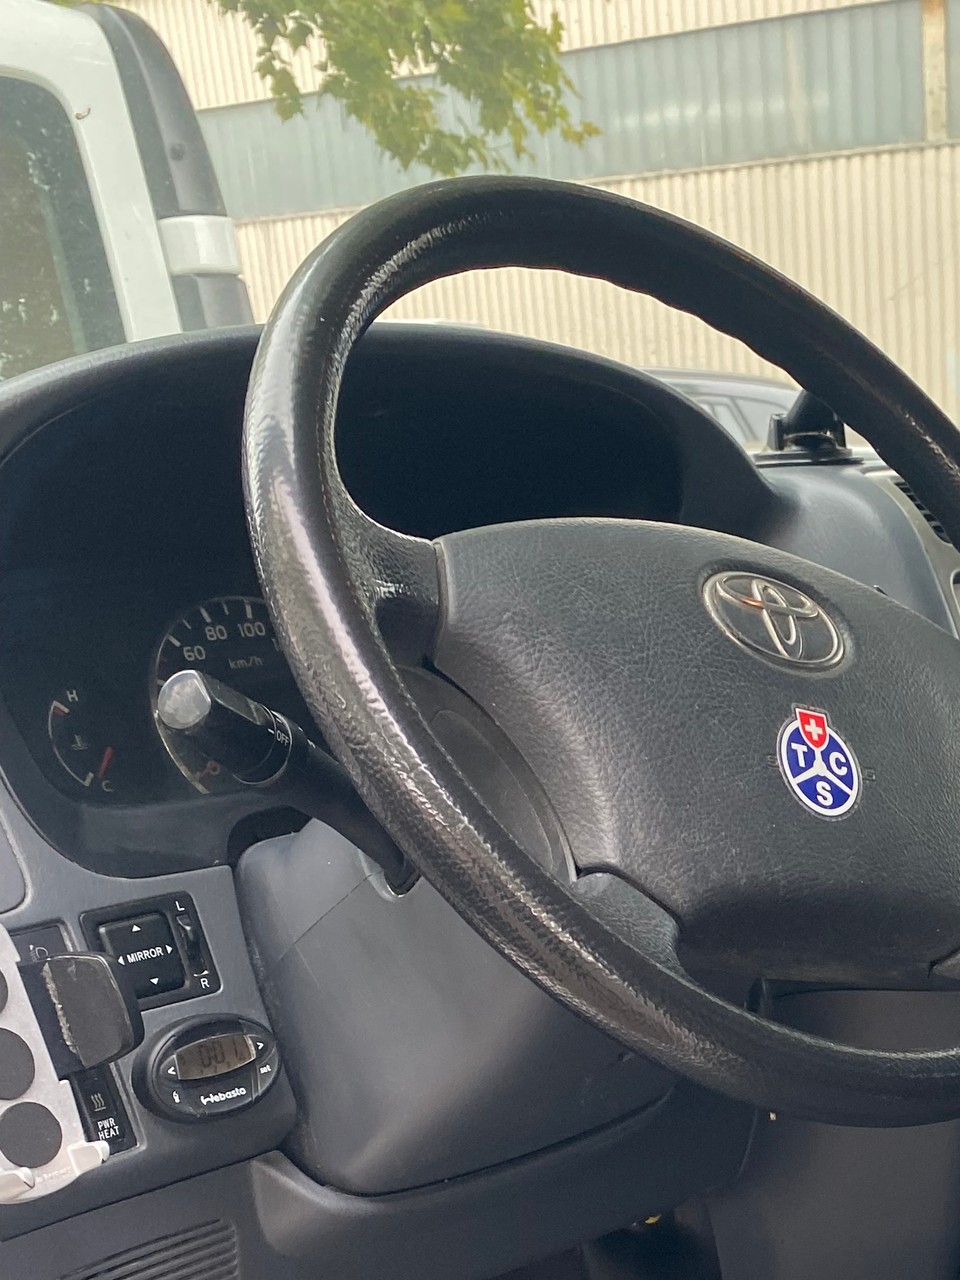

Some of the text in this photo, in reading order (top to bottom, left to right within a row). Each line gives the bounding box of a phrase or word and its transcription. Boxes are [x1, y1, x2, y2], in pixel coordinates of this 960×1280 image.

[205, 625, 228, 641] 80
[238, 621, 266, 638] 100
[183, 645, 206, 661] 60
[228, 655, 263, 669] km/h
[67, 689, 79, 702] H
[276, 730, 290, 747] OFF
[102, 780, 114, 792] C
[175, 900, 186, 912] L
[126, 946, 165, 964] MIRROR
[200, 977, 210, 989] R
[259, 1064, 272, 1074] set
[200, 1087, 247, 1106] Webasto
[97, 1117, 116, 1131] PWR
[97, 1125, 119, 1140] HEAT
